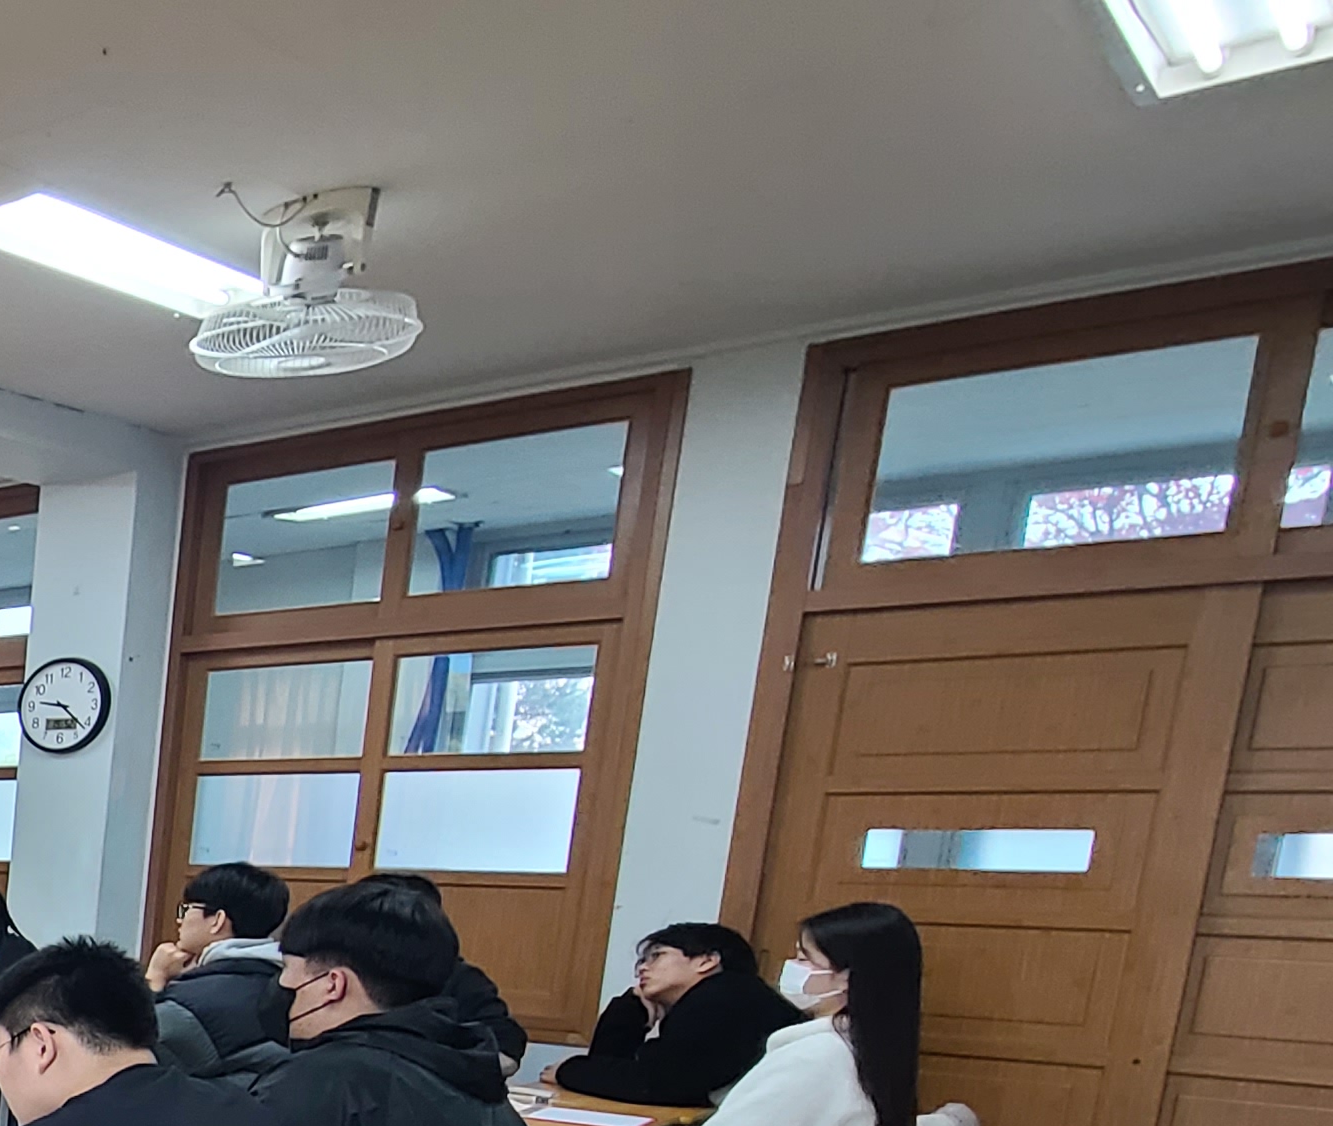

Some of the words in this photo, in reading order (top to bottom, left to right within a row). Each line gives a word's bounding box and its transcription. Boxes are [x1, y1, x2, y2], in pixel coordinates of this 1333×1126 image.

[60, 666, 72, 678] 12
[79, 671, 83, 683] 1
[45, 673, 54, 684] 11
[35, 684, 46, 696] 10
[87, 681, 95, 693] 2
[28, 700, 35, 712] 9
[91, 698, 98, 710] 3
[32, 717, 39, 729] 8
[84, 716, 91, 727] 4
[56, 732, 64, 744] 6
